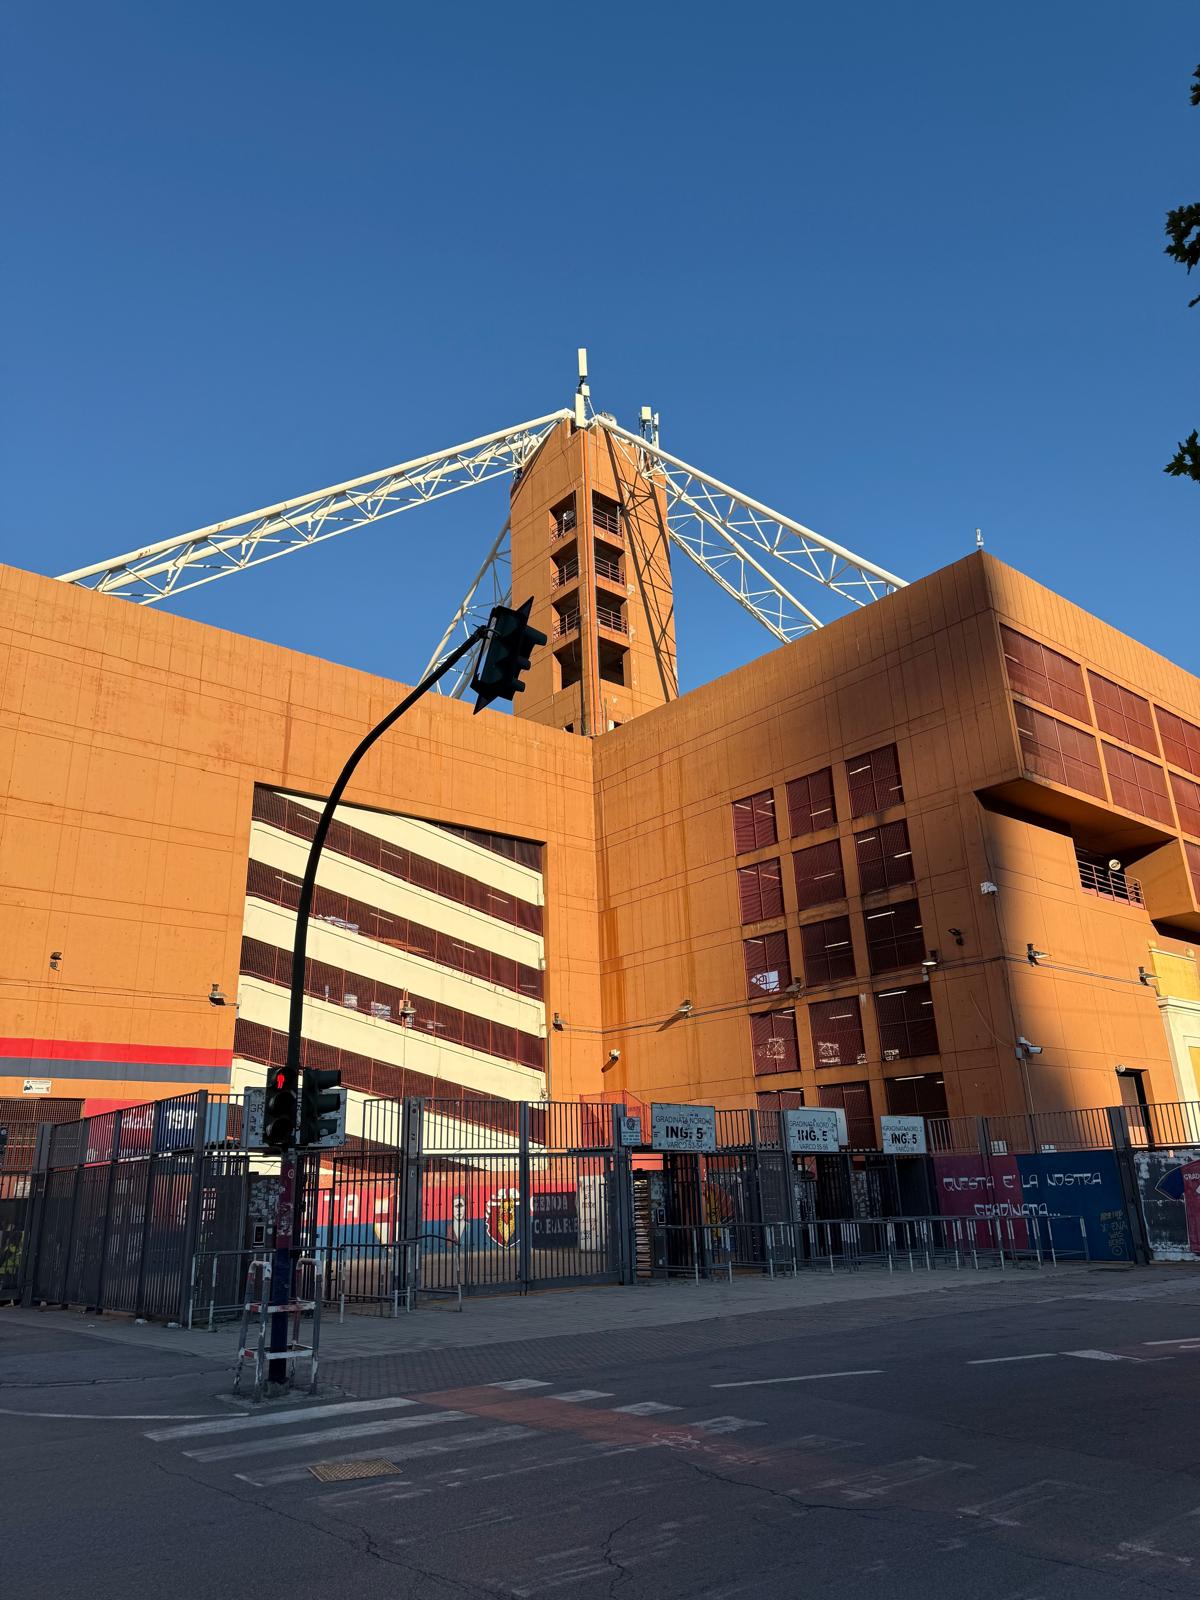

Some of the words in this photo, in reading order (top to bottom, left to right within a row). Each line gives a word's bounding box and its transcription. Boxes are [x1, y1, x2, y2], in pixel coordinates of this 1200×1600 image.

[665, 1126, 693, 1140] ING.
[696, 1127, 704, 1140] 5
[797, 1129, 820, 1141] ING.
[822, 1130, 828, 1142] 5
[891, 1132, 910, 1144] ING.
[912, 1133, 918, 1145] 5
[943, 1175, 995, 1192] QUESTA
[1021, 1174, 1039, 1189] LA
[1047, 1172, 1102, 1187] NOSTRA
